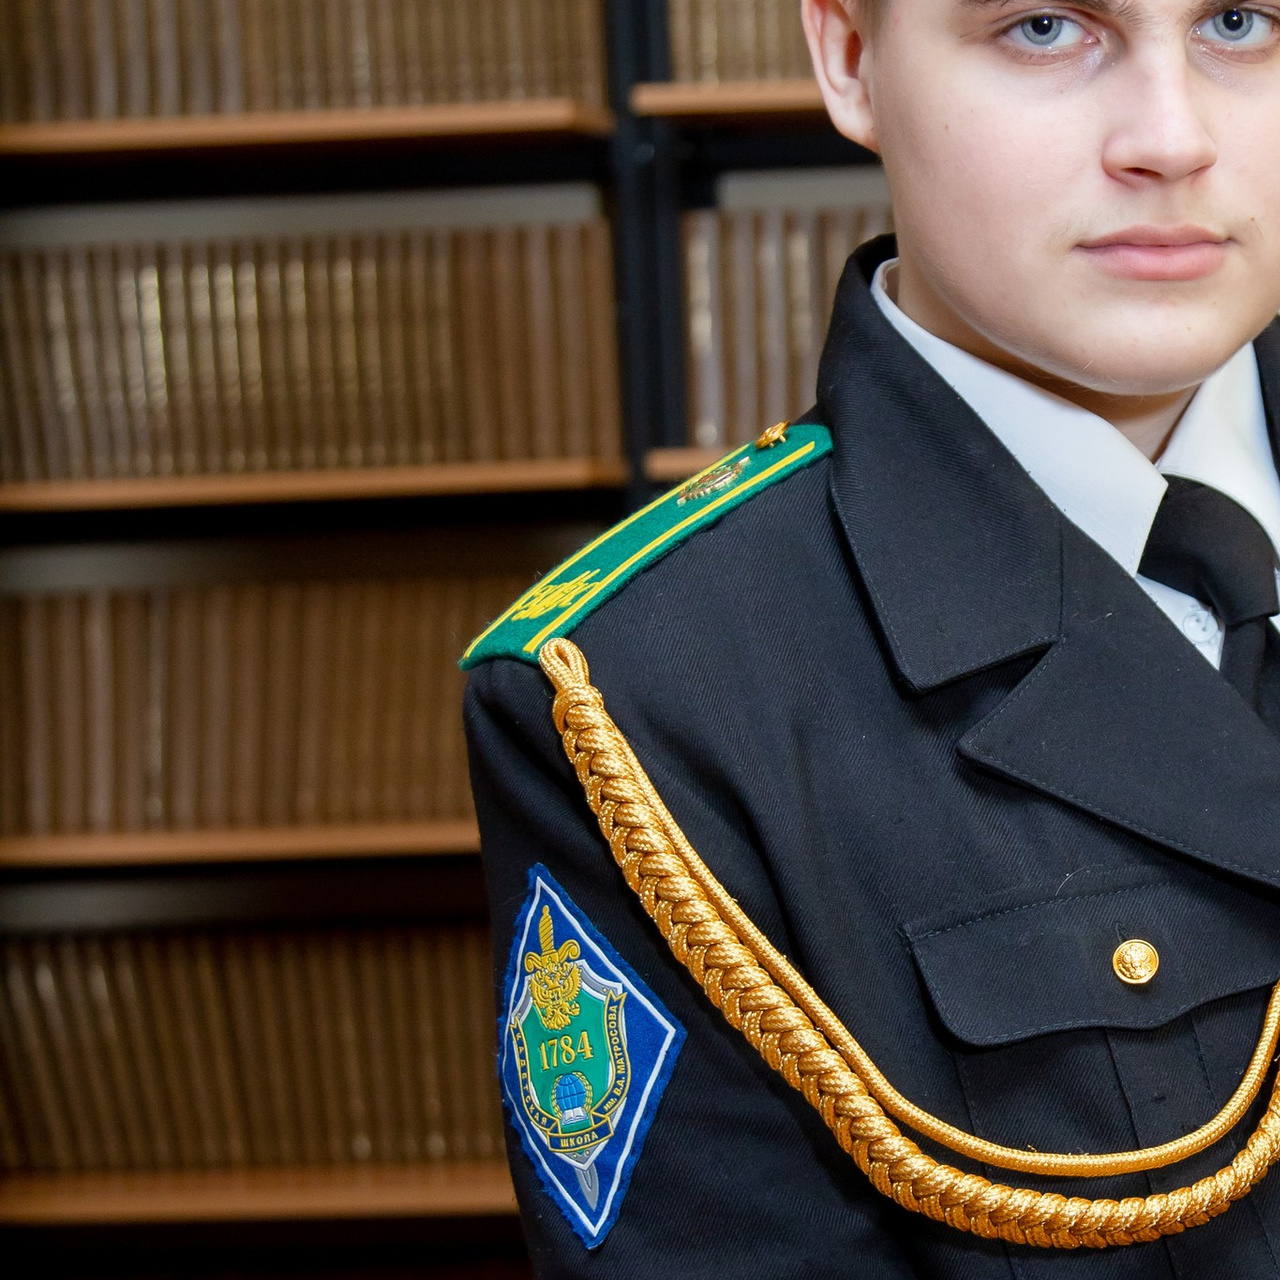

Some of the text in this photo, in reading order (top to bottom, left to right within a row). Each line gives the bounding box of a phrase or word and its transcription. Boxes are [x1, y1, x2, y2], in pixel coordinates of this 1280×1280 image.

[540, 1031, 594, 1070] 1784
[608, 1005, 626, 1074] МАТРОСОВА
[515, 1032, 599, 1148] КАДЕТСКАЯ ШКОЛА
[613, 1076, 626, 1096] В.А.
